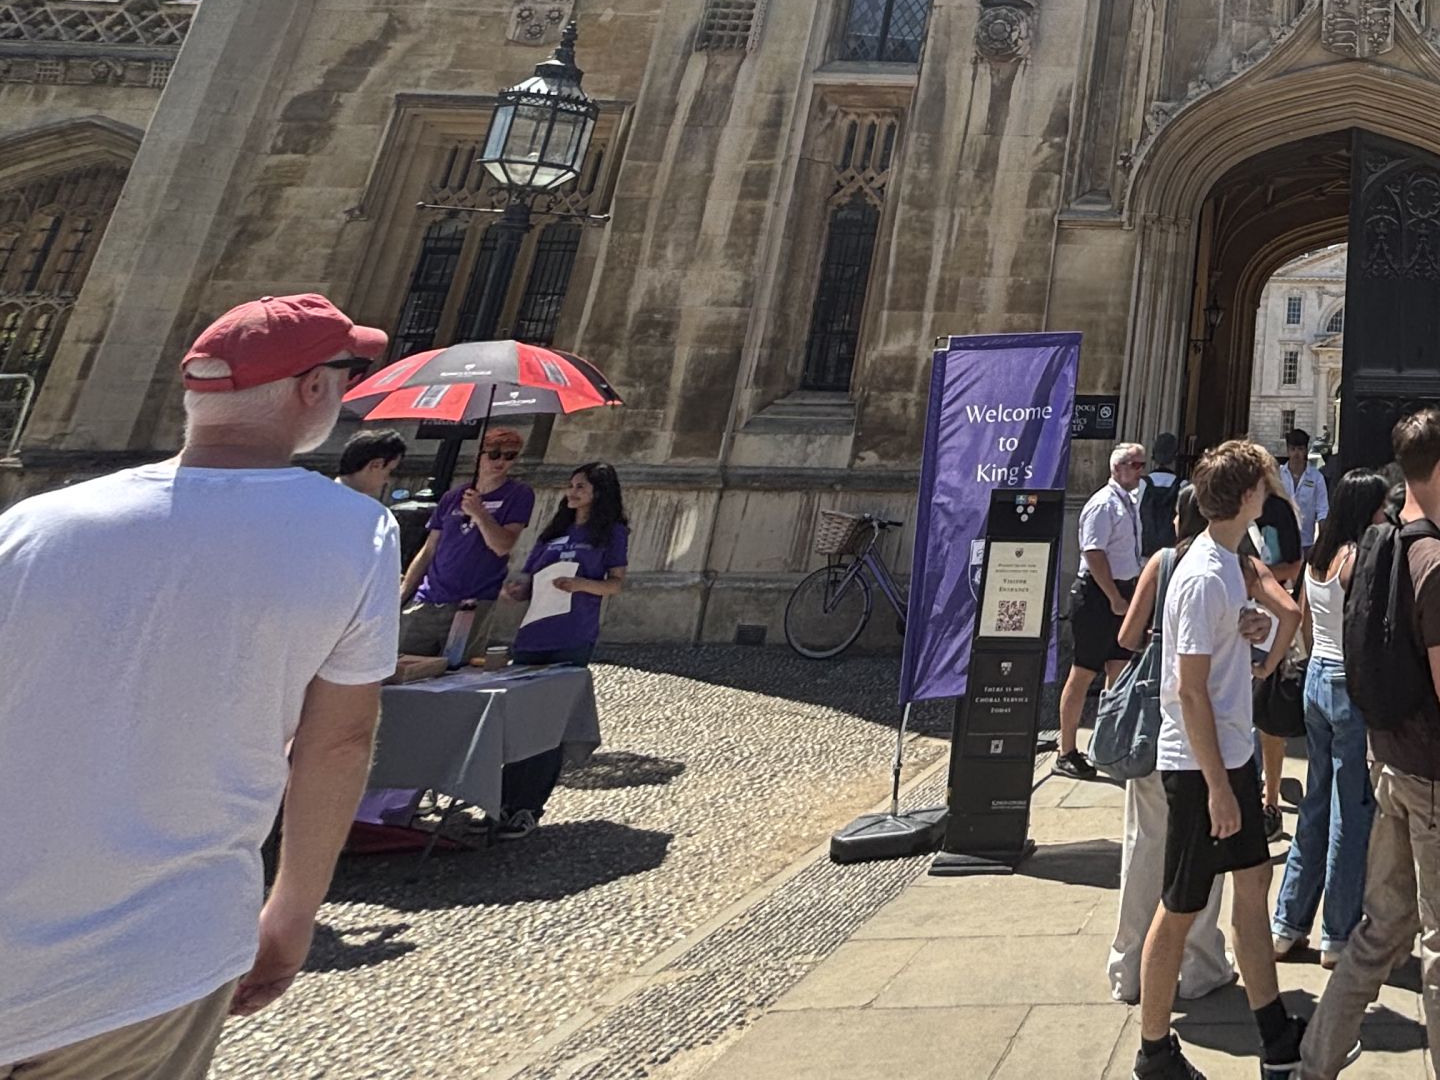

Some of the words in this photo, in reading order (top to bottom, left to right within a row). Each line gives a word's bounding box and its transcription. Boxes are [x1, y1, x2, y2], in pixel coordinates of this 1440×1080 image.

[966, 404, 1053, 424] Welcome
[999, 437, 1018, 452] to
[976, 461, 1033, 486] King's
